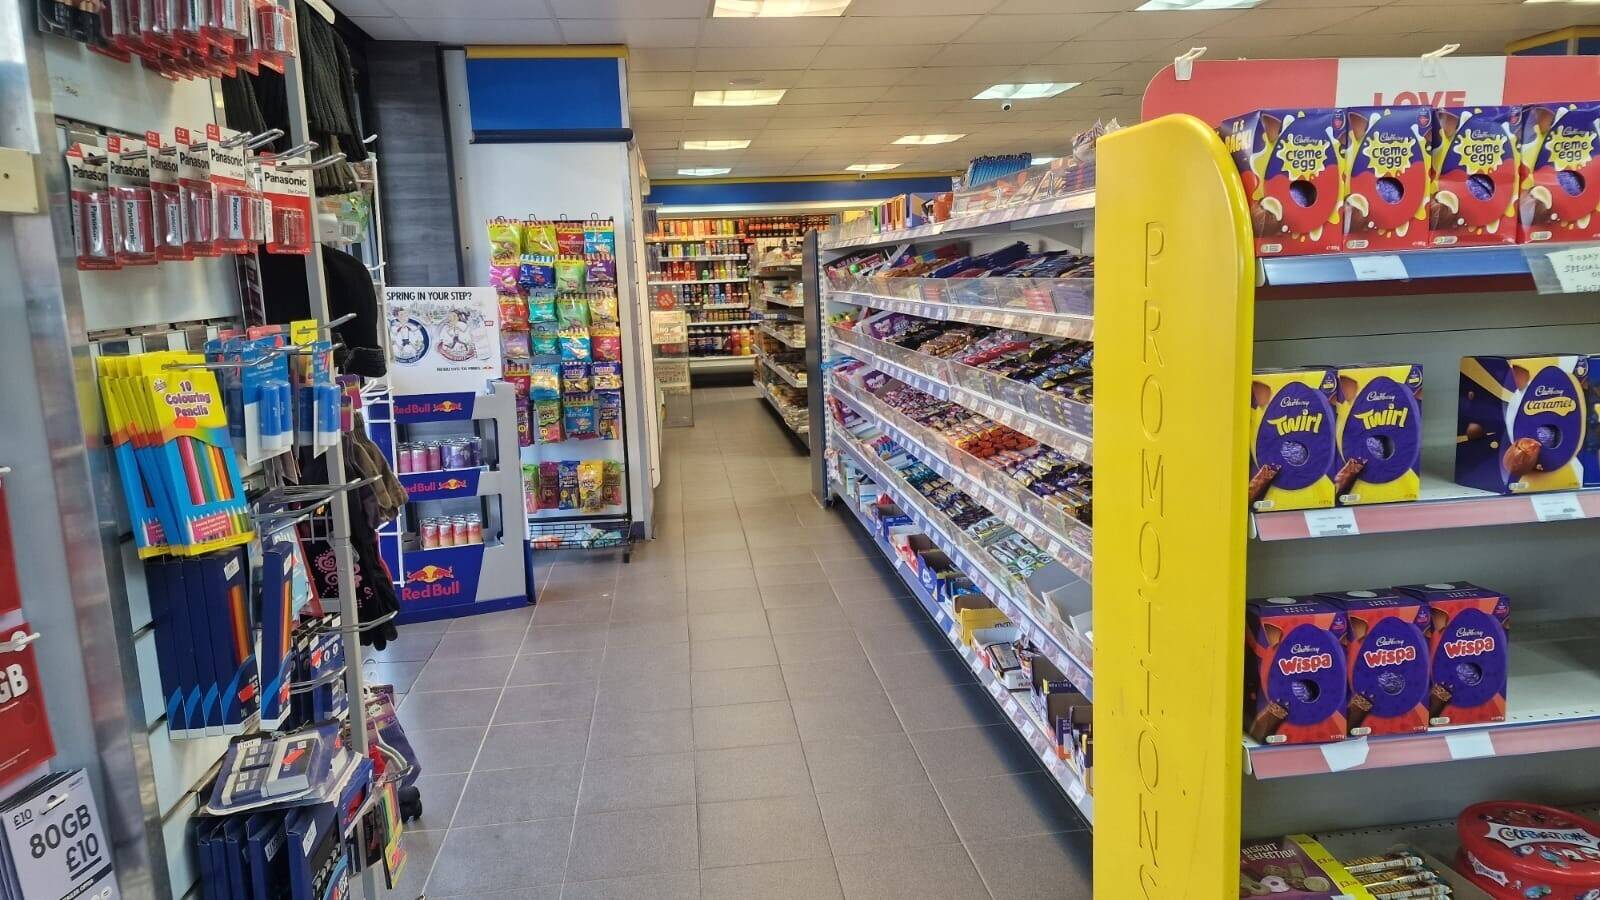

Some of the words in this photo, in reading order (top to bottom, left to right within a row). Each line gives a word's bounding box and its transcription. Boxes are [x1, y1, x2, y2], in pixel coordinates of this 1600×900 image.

[1372, 146, 1408, 159] creme
[1464, 143, 1499, 156] creme
[1553, 140, 1588, 153] creme
[211, 148, 243, 167] Panasonic
[1286, 148, 1322, 161] creme
[1470, 152, 1493, 166] egg
[1558, 149, 1581, 163] egg
[1292, 159, 1316, 172] egg
[1378, 156, 1402, 169] egg
[264, 171, 307, 187] Panasonic
[386, 291, 415, 301] SPRING
[417, 291, 426, 300] IN
[428, 291, 449, 301] YOUR
[451, 291, 472, 300] STEP?
[180, 381, 192, 392] 10
[1535, 385, 1564, 397] Cadbury
[165, 392, 211, 405] Colouring
[1280, 396, 1310, 408] Cadbury
[1366, 391, 1395, 402] Cadbury
[175, 404, 209, 417] Pencils
[1526, 399, 1573, 411] Caramel
[1266, 409, 1322, 436] Twirl
[1354, 403, 1408, 430] Twirl
[402, 586, 431, 601] Red
[432, 581, 461, 598] Bull
[1456, 627, 1484, 638] Cadbury
[1375, 636, 1405, 647] Cadbury
[1443, 636, 1495, 659] Wispa
[1290, 643, 1320, 654] Cadbury
[1363, 645, 1416, 668] Wispa
[1278, 653, 1333, 676] Wispa
[13, 808, 33, 826] £10
[30, 804, 91, 859] 80GB
[66, 832, 99, 872] £10
[1242, 843, 1279, 855] BISCUIT
[1247, 848, 1297, 861] SELECTION
